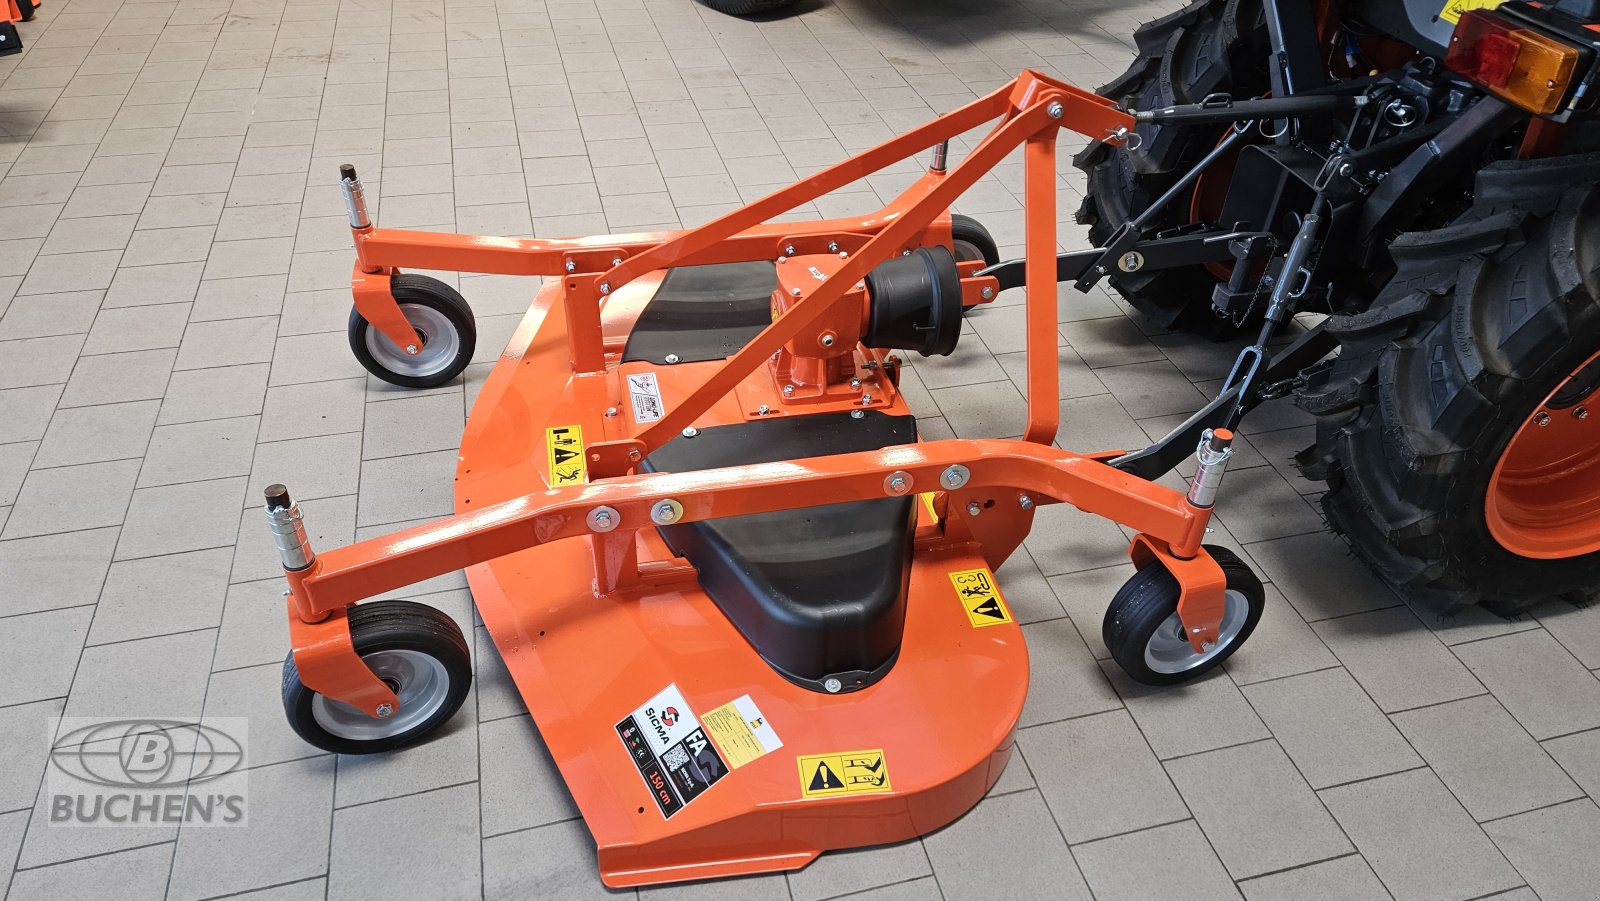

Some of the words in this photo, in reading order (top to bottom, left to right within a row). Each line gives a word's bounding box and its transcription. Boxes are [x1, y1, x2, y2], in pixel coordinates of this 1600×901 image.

[645, 707, 670, 744] SICMA
[686, 729, 707, 757] FA
[649, 771, 664, 790] 150
[660, 789, 671, 805] cm
